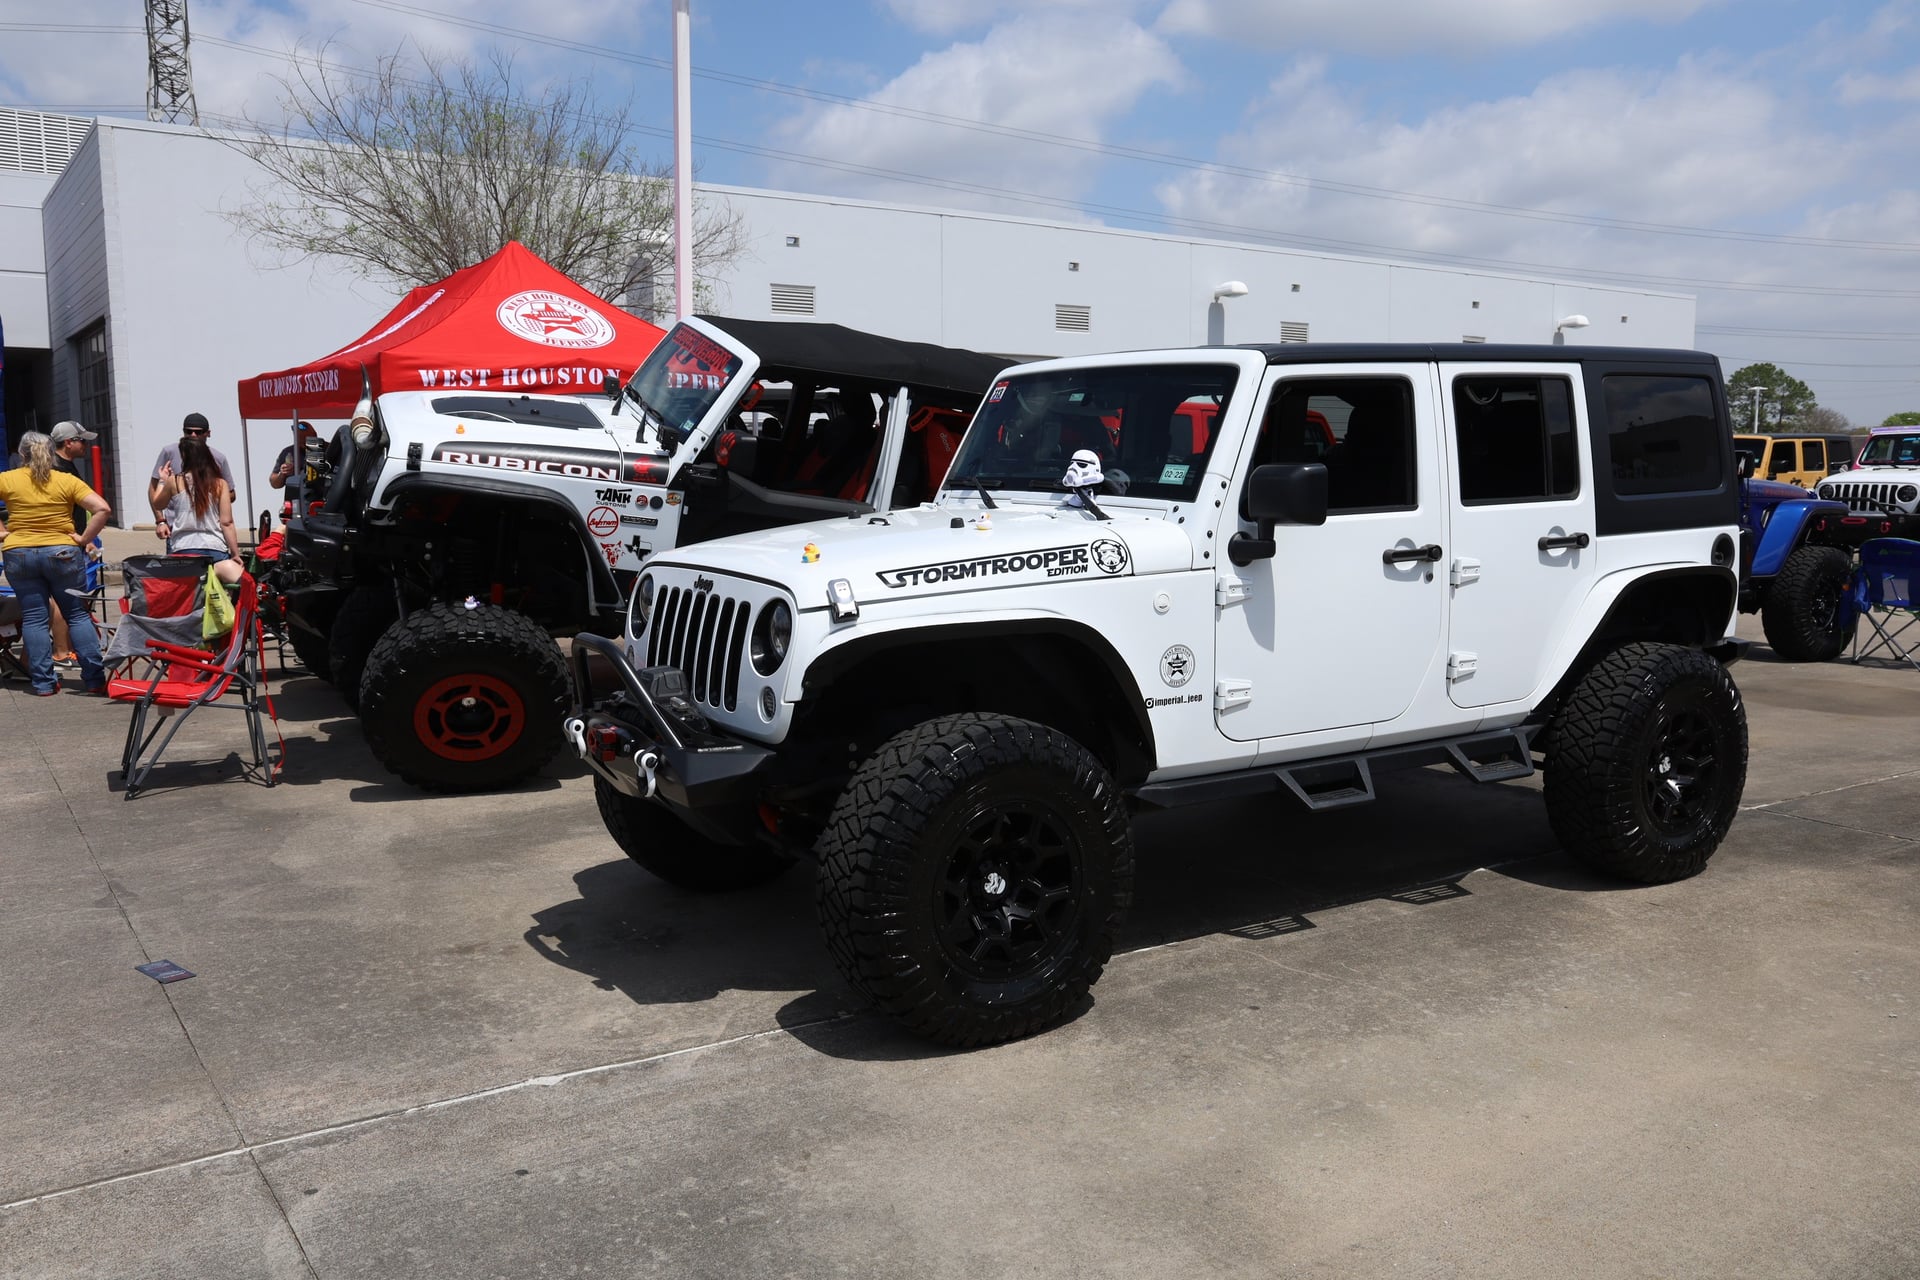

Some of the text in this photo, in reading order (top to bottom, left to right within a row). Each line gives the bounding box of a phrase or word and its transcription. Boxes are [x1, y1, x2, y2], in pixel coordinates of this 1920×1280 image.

[505, 293, 590, 314] WEST HOUSTON
[543, 337, 598, 347] JEEPERS
[304, 369, 339, 393] JEEPERS
[419, 369, 490, 387] WEST
[440, 450, 618, 481] RUBICON
[595, 488, 633, 504] TANK
[876, 544, 1089, 588] STORMTROOPER
[1046, 564, 1088, 577] EDITION
[693, 574, 714, 594] Jeep
[1155, 694, 1202, 706] imperial_jeep
